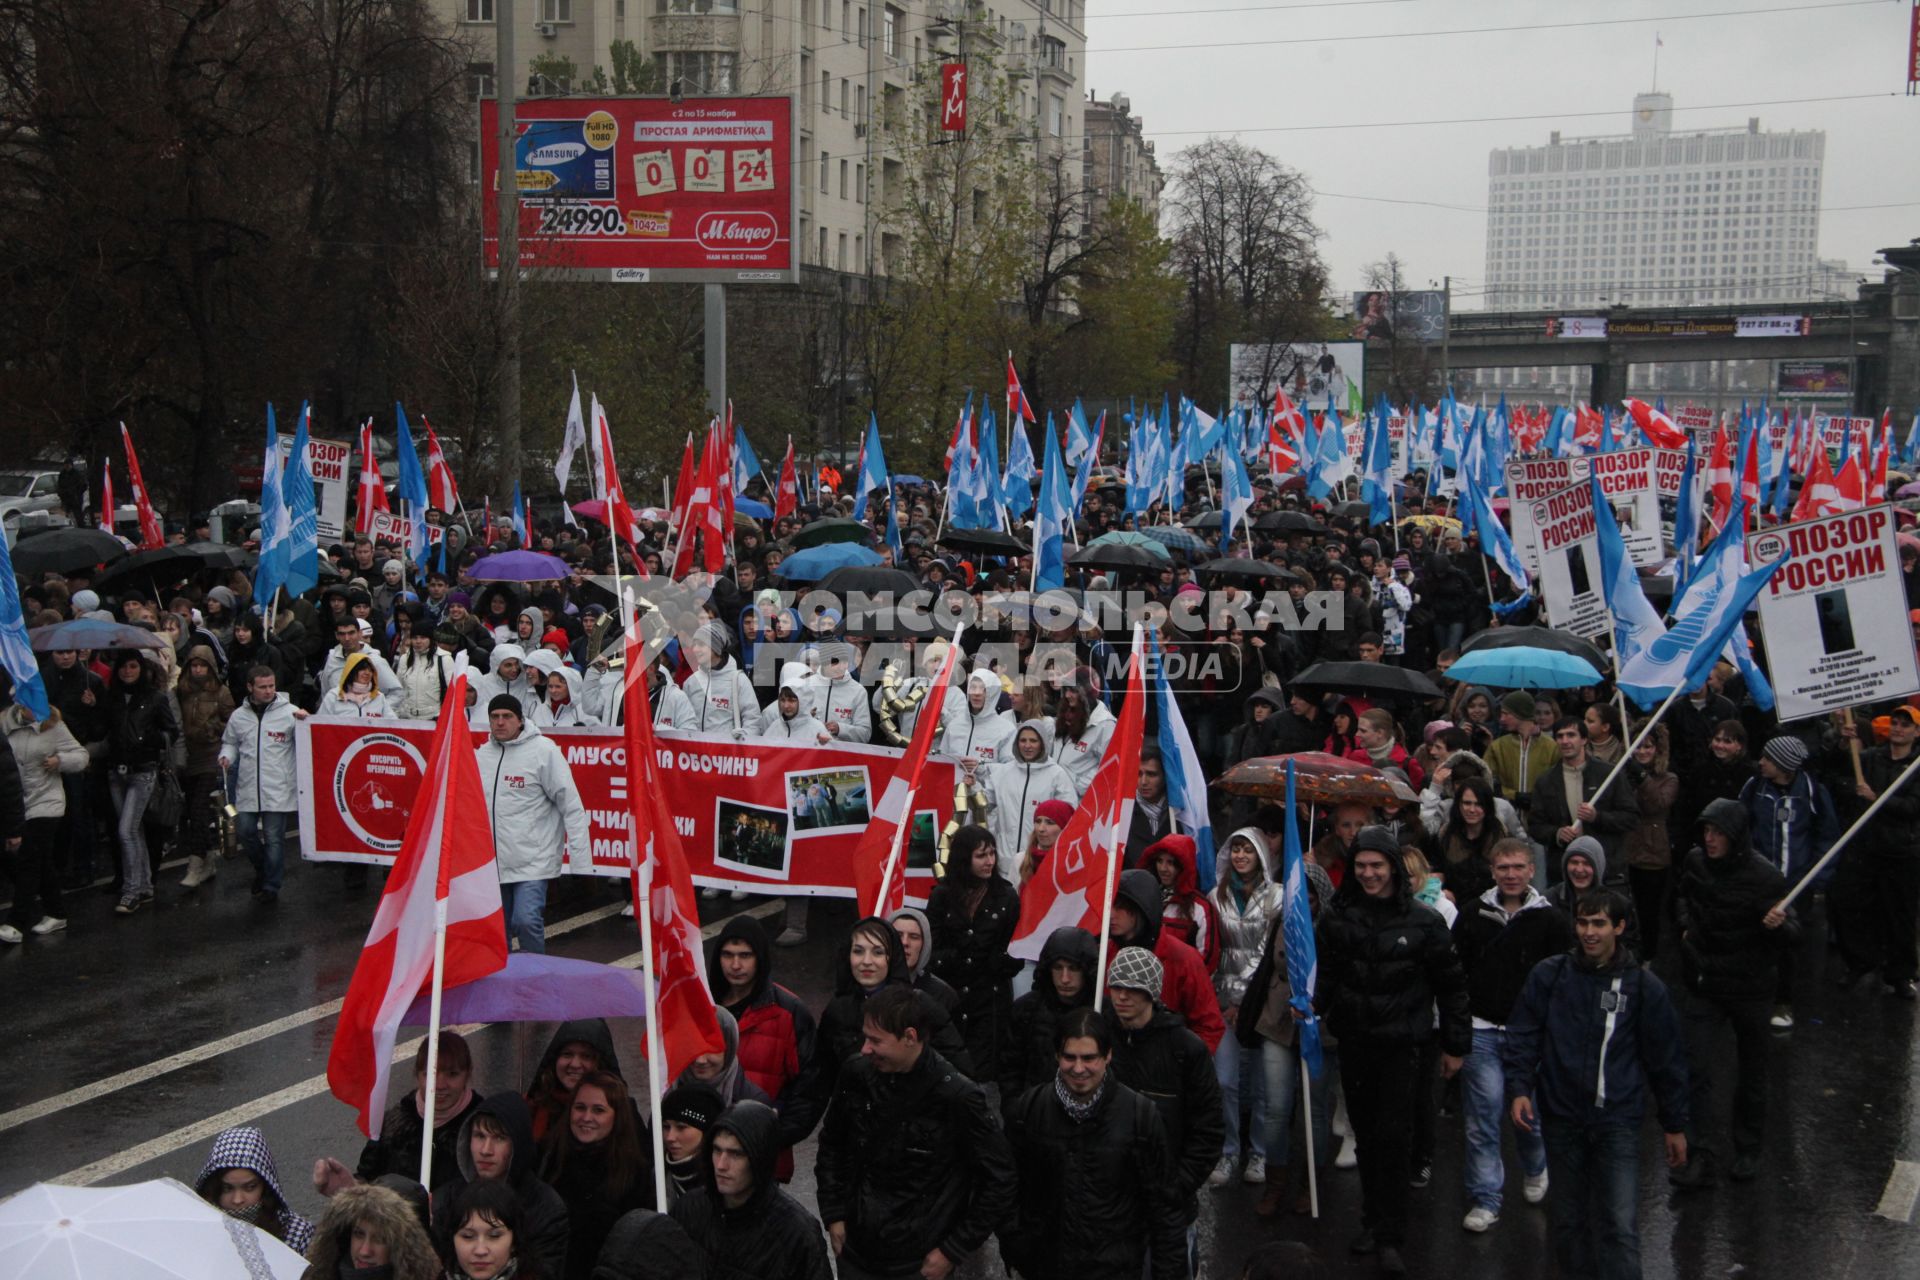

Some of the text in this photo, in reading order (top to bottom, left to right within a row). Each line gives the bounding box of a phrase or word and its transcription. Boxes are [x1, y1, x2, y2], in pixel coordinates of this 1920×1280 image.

[706, 109, 737, 118] ноября
[586, 122, 615, 131] Full HD
[640, 126, 766, 136] ПРОСТАЯ АРИФМЕТИКА
[592, 133, 611, 142] 1080
[533, 149, 579, 159] SAMSUNG
[646, 162, 662, 187] 0
[693, 156, 709, 180] 0
[738, 160, 768, 183] 24
[634, 219, 656, 231] 1042
[702, 220, 771, 243] М.видео
[616, 269, 645, 281] Gallery
[1572, 320, 1582, 335] 8
[1608, 322, 1650, 334] Клубный
[1651, 323, 1671, 333] Дом
[1684, 407, 1712, 418] ПОЗОР
[1676, 416, 1710, 427] РОССИИ
[308, 442, 347, 463] ОЗОР
[1595, 450, 1651, 475] ПОЗОР
[1657, 452, 1705, 475] ПОЗР
[1542, 510, 1596, 551] РОССИИ
[1788, 511, 1886, 558] ПОЗОР
[1759, 541, 1779, 552] СТОП
[1770, 544, 1886, 595] РОССИИ
[369, 754, 402, 765] МУСОРИТЬ
[677, 752, 758, 777] ОБОЧИНУ
[367, 764, 407, 777] ПРЕКРАЩАЕМ
